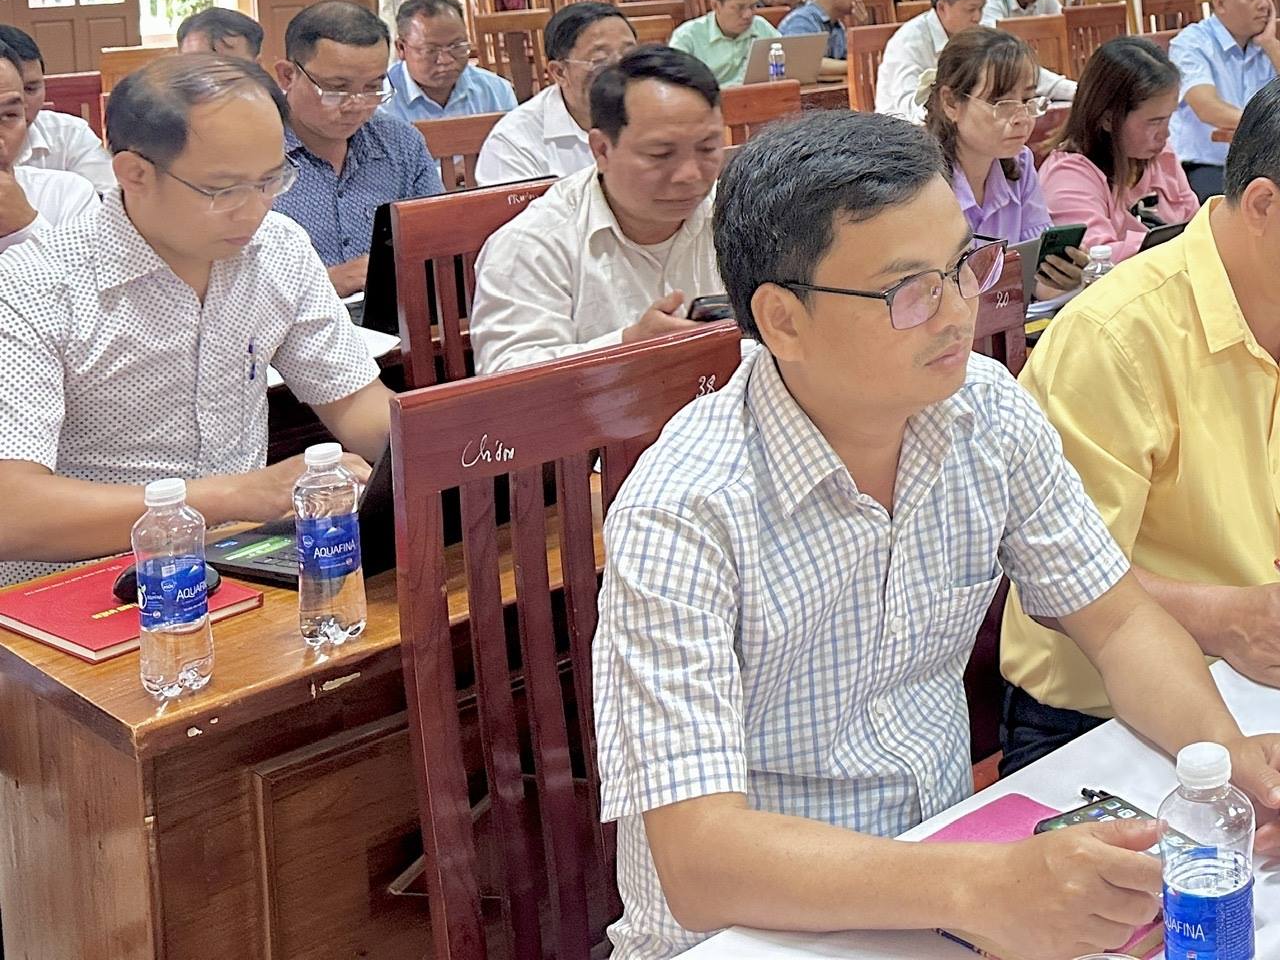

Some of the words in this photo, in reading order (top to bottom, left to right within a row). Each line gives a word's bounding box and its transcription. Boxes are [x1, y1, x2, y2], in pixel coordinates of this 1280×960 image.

[313, 538, 356, 560] AQUAFINA
[176, 580, 207, 602] AQUAF
[1163, 911, 1206, 942] UAFINA
